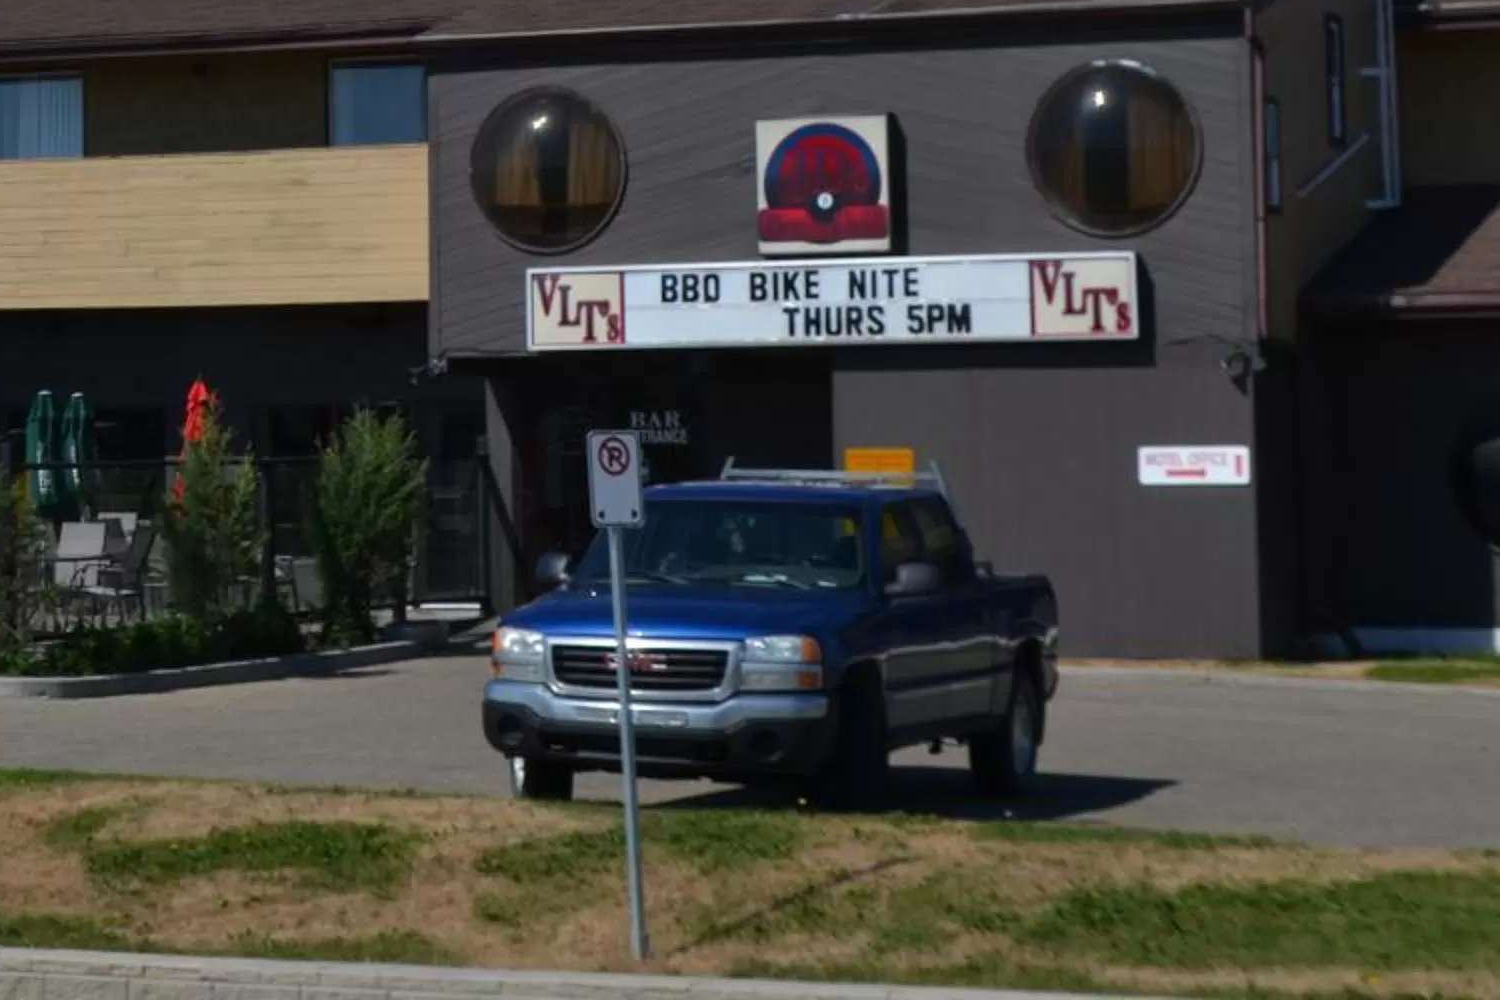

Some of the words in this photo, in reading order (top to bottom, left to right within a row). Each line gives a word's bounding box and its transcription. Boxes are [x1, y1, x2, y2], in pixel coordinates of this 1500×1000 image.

[749, 269, 820, 302] BIKE
[848, 267, 920, 300] NITE
[782, 304, 885, 337] THURS
[907, 303, 973, 335] 5PM
[630, 410, 681, 429] BAR
[641, 428, 689, 445] TRANCE
